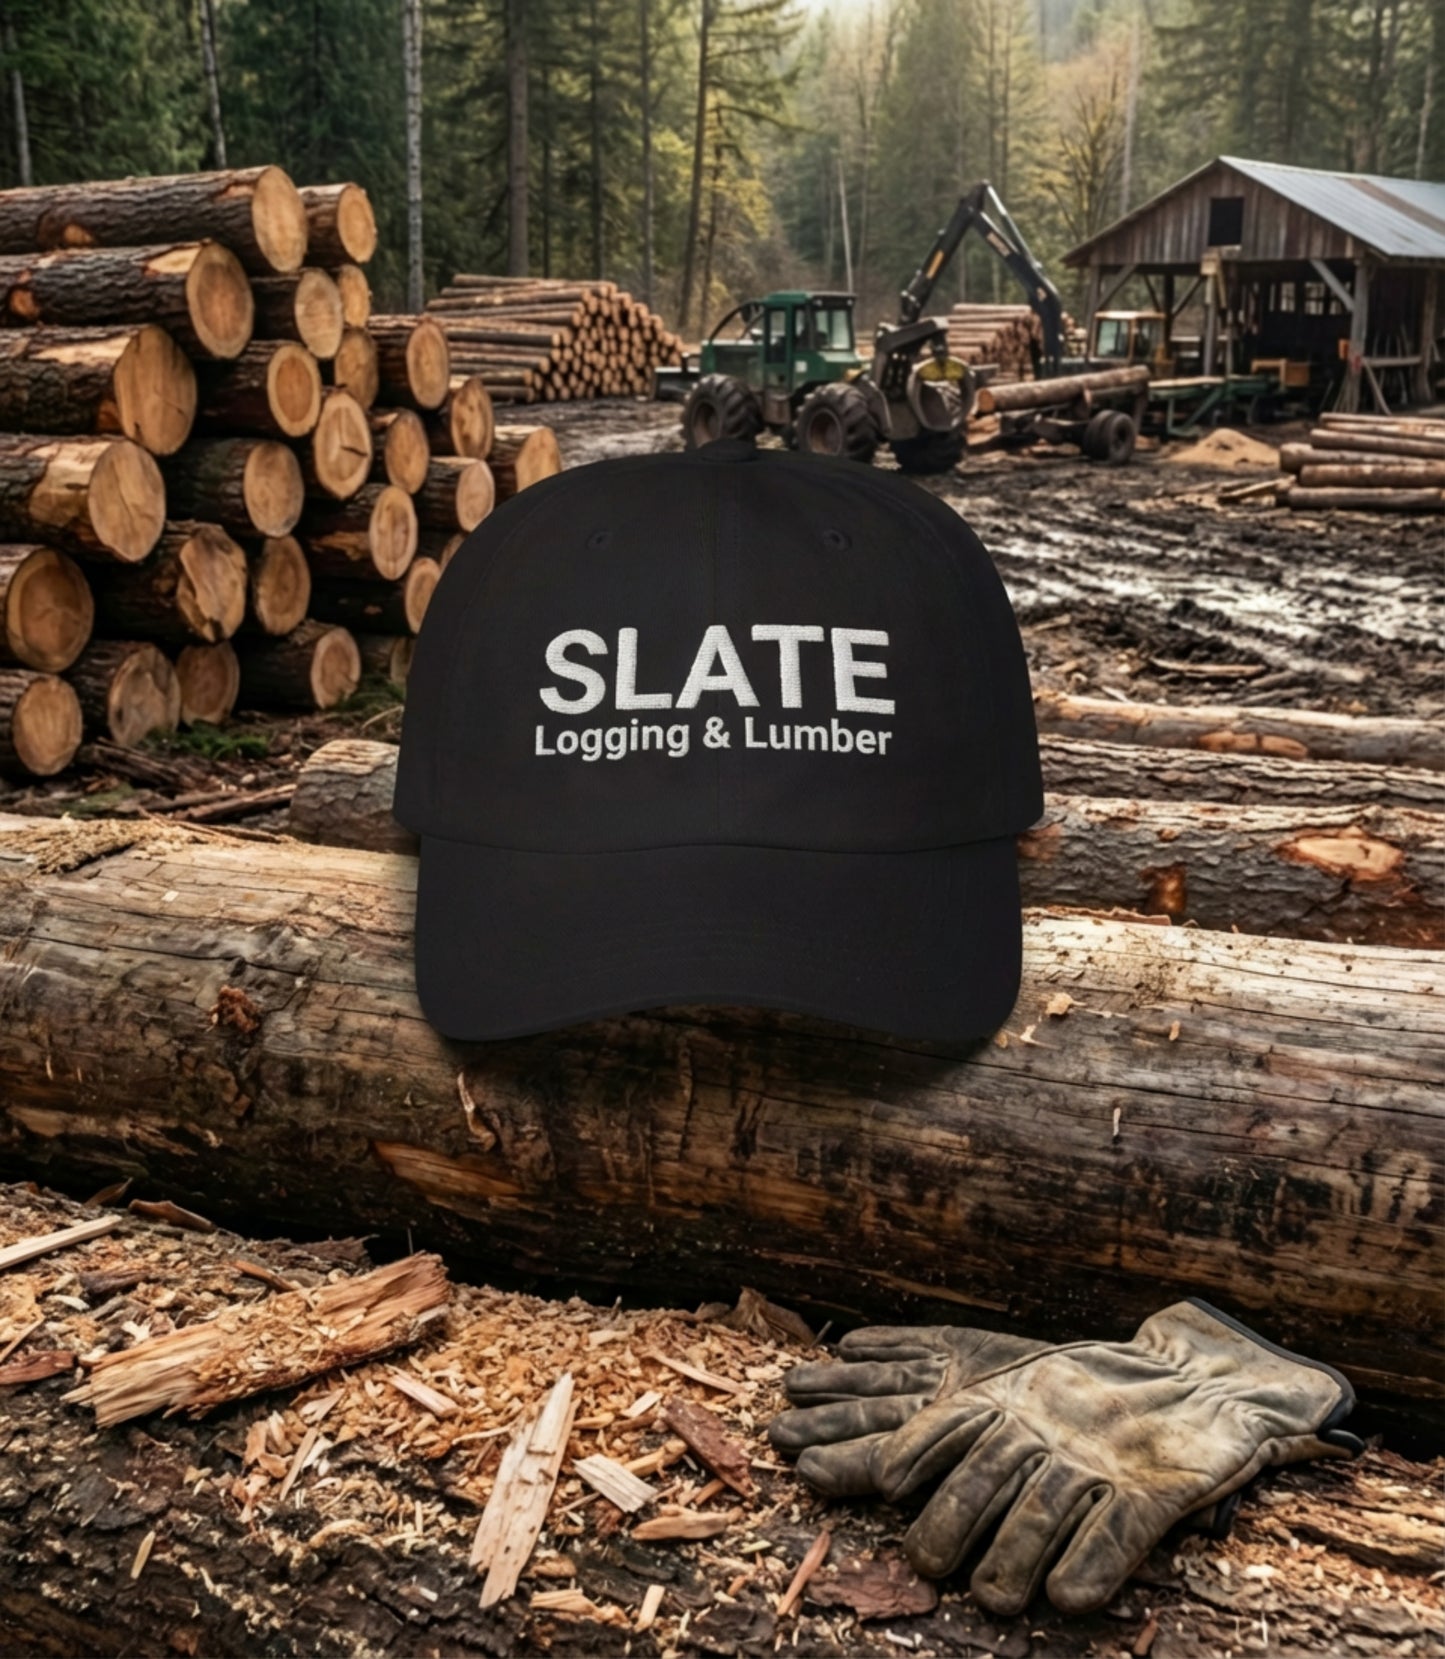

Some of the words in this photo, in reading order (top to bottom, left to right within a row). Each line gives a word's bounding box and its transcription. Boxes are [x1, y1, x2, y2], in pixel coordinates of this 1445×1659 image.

[539, 624, 896, 715] SLATE
[535, 718, 690, 762] Logging
[702, 716, 731, 749] &
[744, 716, 893, 755] Lumber
